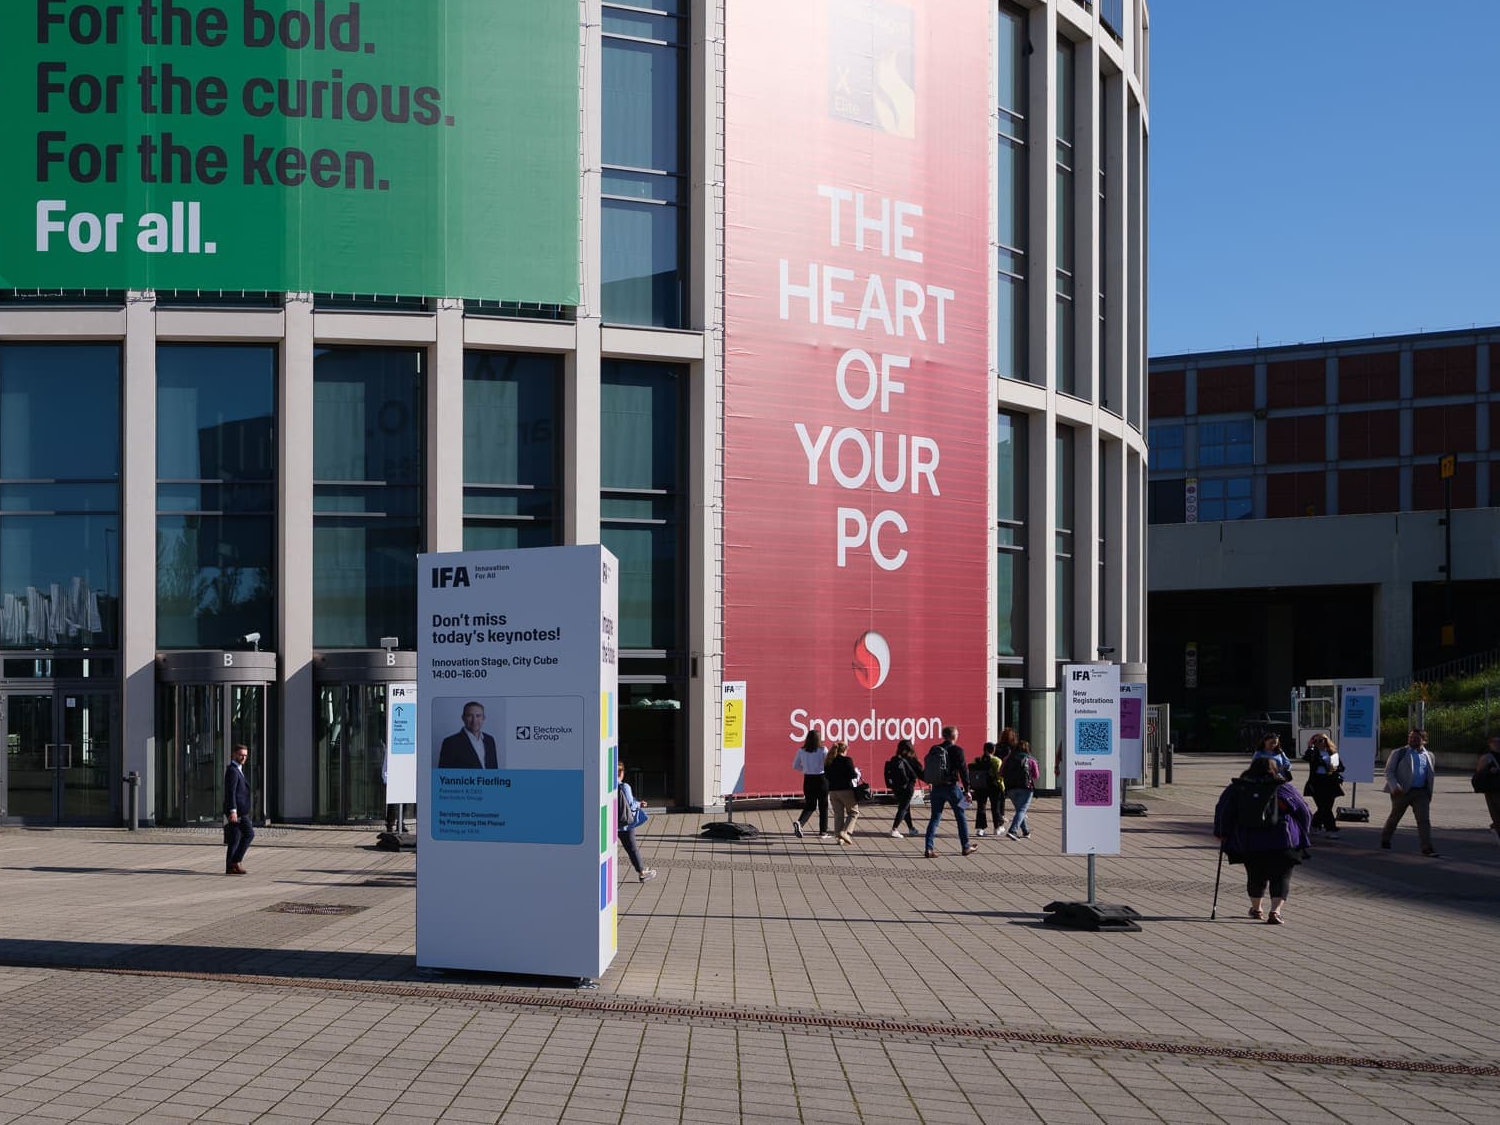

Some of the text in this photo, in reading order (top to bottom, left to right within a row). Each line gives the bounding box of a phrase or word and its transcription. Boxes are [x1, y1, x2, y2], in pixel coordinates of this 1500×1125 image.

[36, 61, 455, 127] For the curious.
[36, 130, 390, 191] For the keen.
[36, 200, 217, 254] For all.
[817, 184, 923, 263] THE
[779, 259, 954, 344] HEART
[836, 348, 910, 413] OF
[794, 422, 940, 497] YOUR
[837, 508, 909, 571] PC
[431, 564, 510, 588] IFA Innovation
[473, 613, 507, 625] miss
[488, 627, 561, 645] keynotes!
[223, 653, 233, 667] B
[386, 652, 396, 666] B
[432, 655, 559, 668] Innovation Stage, City Cube
[1072, 670, 1090, 681] IFA
[392, 688, 405, 697] IFA
[725, 685, 735, 693] IFA
[1072, 697, 1114, 705] Registrations
[533, 726, 573, 734] Electrolux
[789, 708, 943, 746] Snapdragon
[533, 733, 560, 741] Group
[439, 776, 475, 786] Yannick
